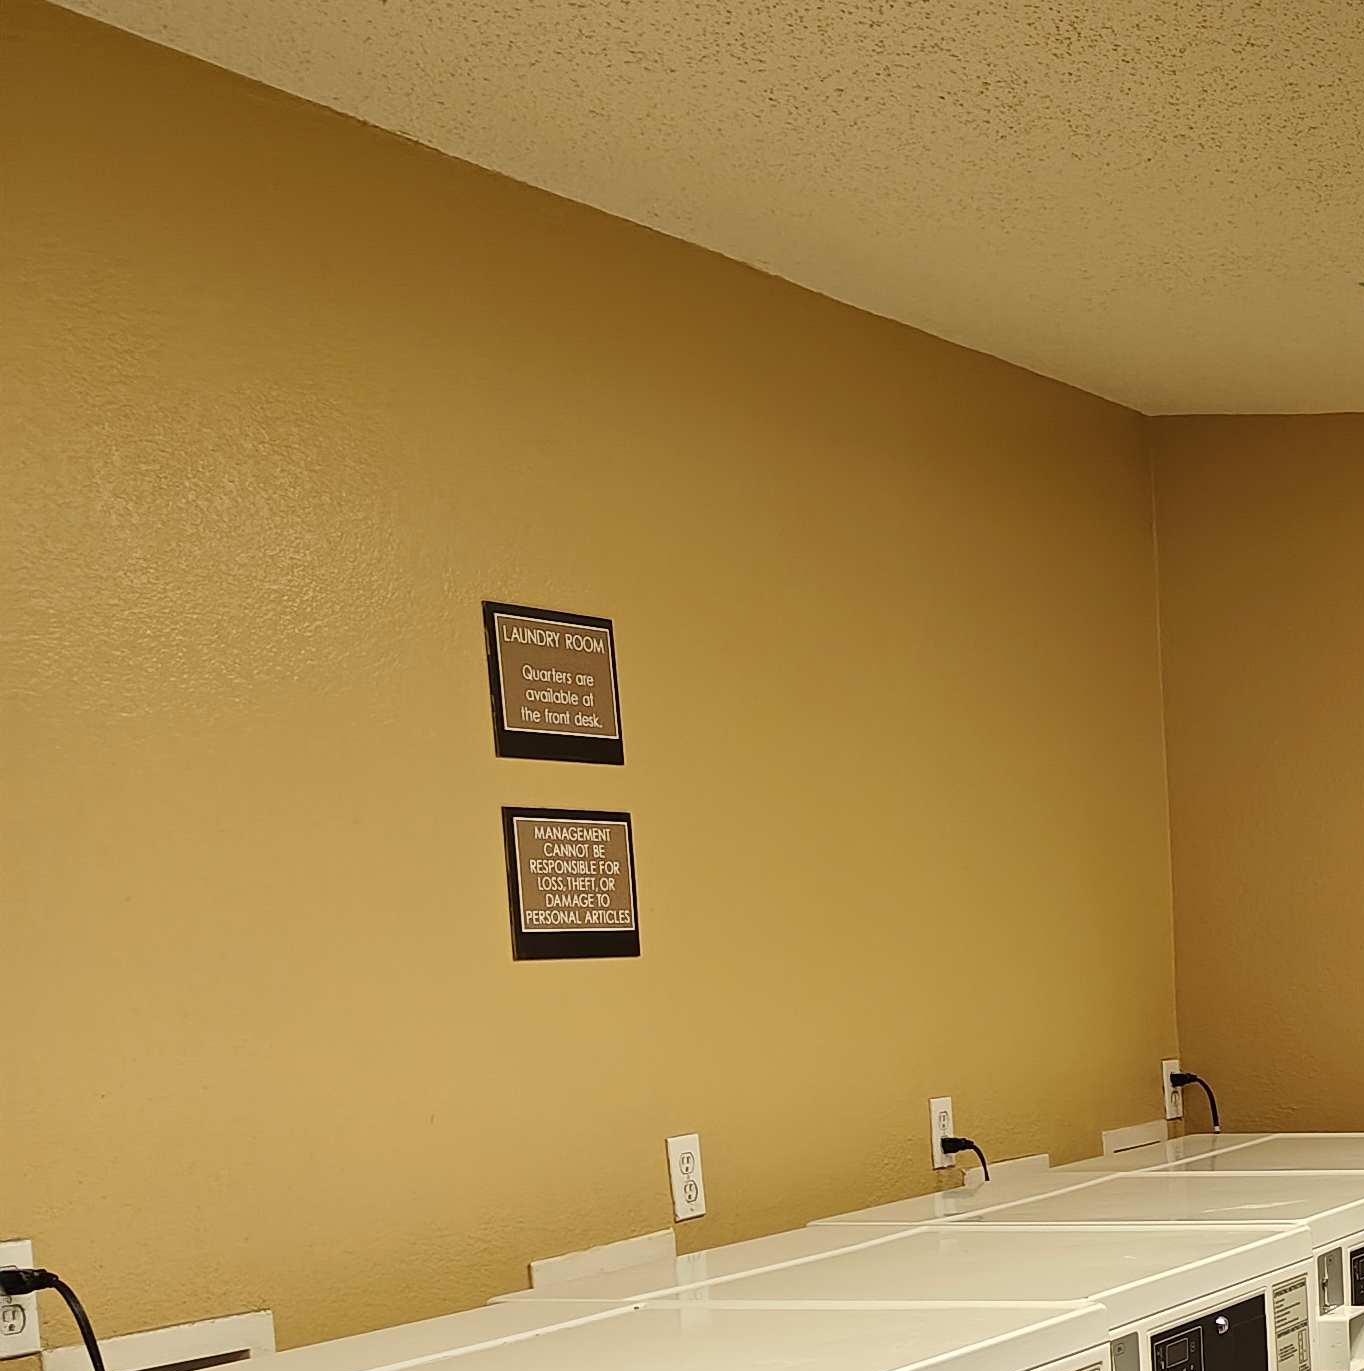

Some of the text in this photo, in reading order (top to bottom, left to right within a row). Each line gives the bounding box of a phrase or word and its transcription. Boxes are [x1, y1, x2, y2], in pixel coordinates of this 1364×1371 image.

[503, 624, 605, 654] LAUNDRY ROOM
[522, 664, 594, 686] Quarters are
[526, 688, 594, 707] available at
[521, 706, 603, 728] the front desk.
[534, 826, 611, 842] MANAGEMENT
[543, 842, 606, 858] CANNOT BE
[529, 859, 620, 875] RESPONSIBLE FOR
[545, 893, 611, 908] DAMAGE TO
[525, 909, 631, 925] PERSONAL ARTICLES
